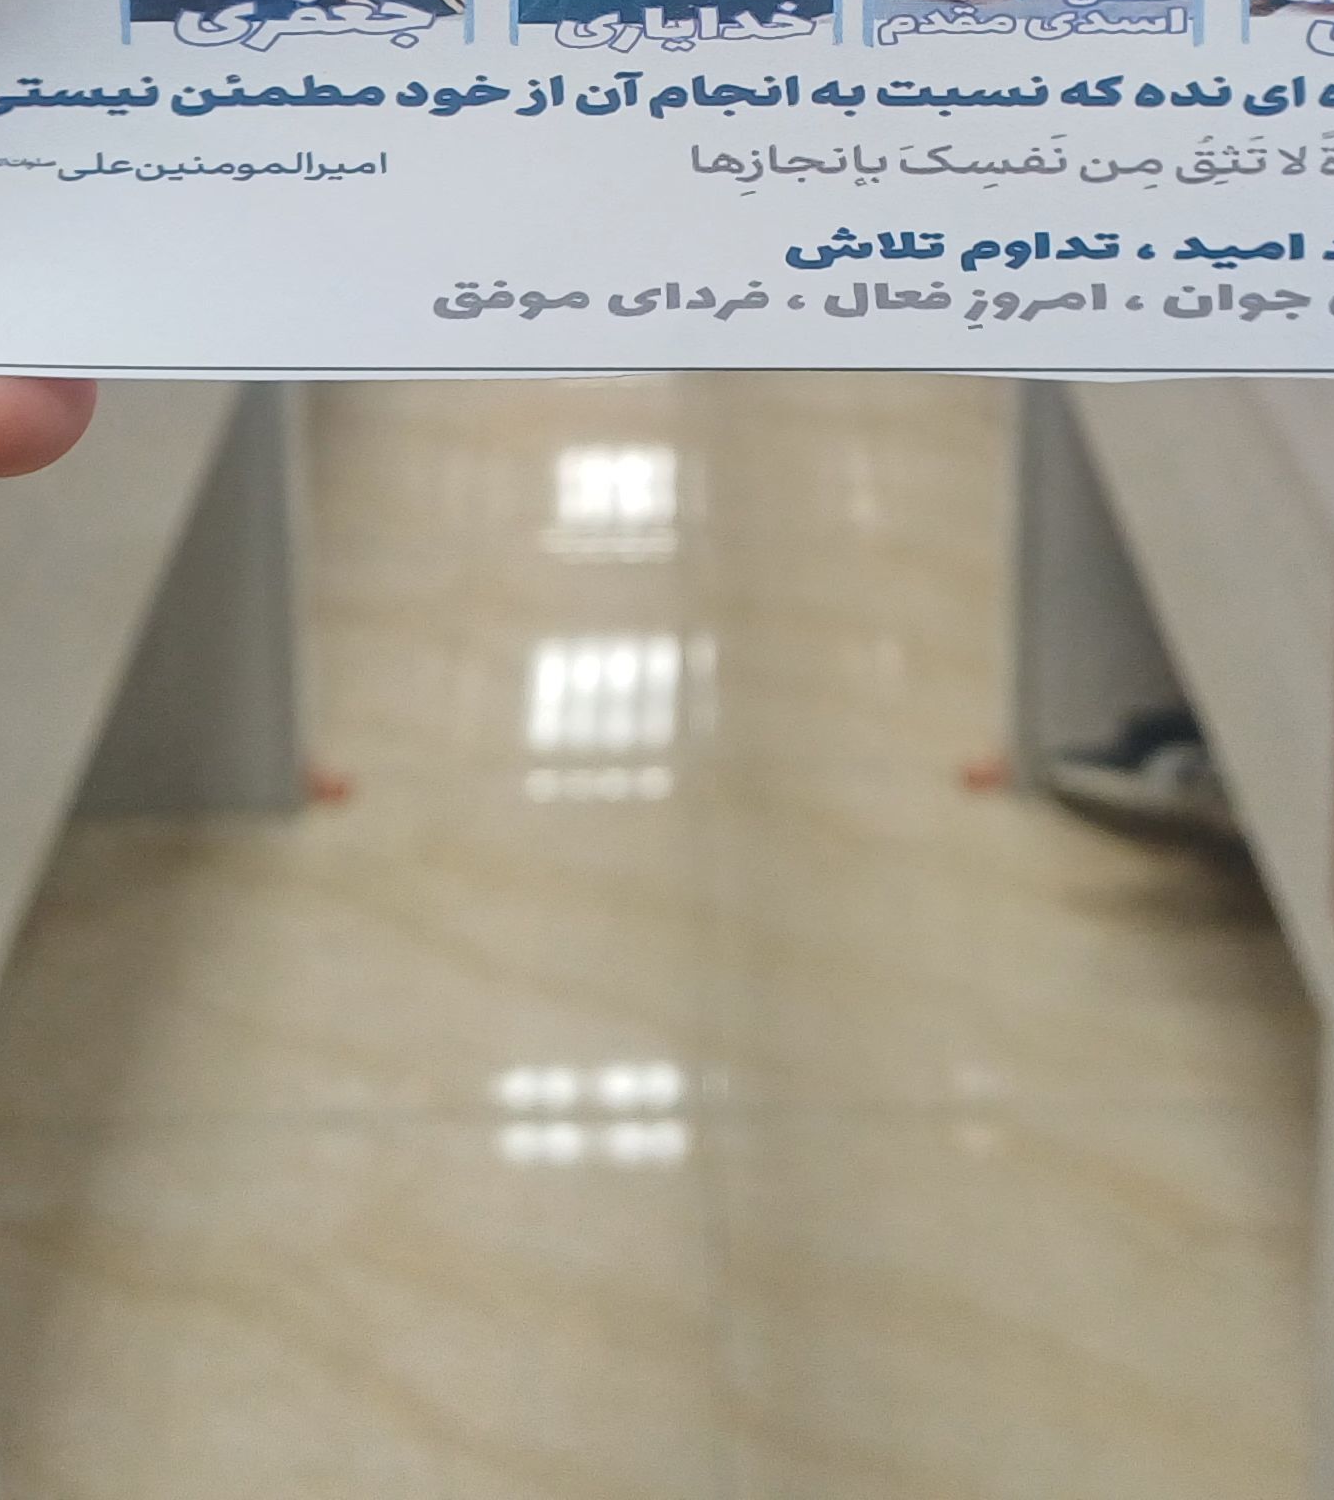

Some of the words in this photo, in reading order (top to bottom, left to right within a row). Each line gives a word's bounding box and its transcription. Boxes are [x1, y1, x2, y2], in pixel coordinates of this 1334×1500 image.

[555, 0, 818, 53] خدایاری
[877, 4, 1018, 46] مقدم
[1024, 5, 1189, 41] اسدی
[170, 73, 387, 118] مطمئن
[395, 74, 512, 118] خود
[513, 74, 565, 117] از
[575, 70, 644, 117] آن
[648, 74, 801, 120] انجام
[810, 79, 866, 118] به
[876, 75, 1050, 118] نسبت
[1059, 74, 1125, 108] که
[1133, 75, 1233, 109] نده
[1242, 75, 1307, 118] ای
[1277, 145, 1307, 176] لا
[784, 226, 946, 271] تلاش
[960, 231, 1121, 273] تداوم
[1172, 232, 1306, 270] امید
[432, 279, 590, 321] موفق
[607, 279, 770, 322] فردای
[823, 280, 952, 319] فعال
[1162, 283, 1312, 323] جوان
